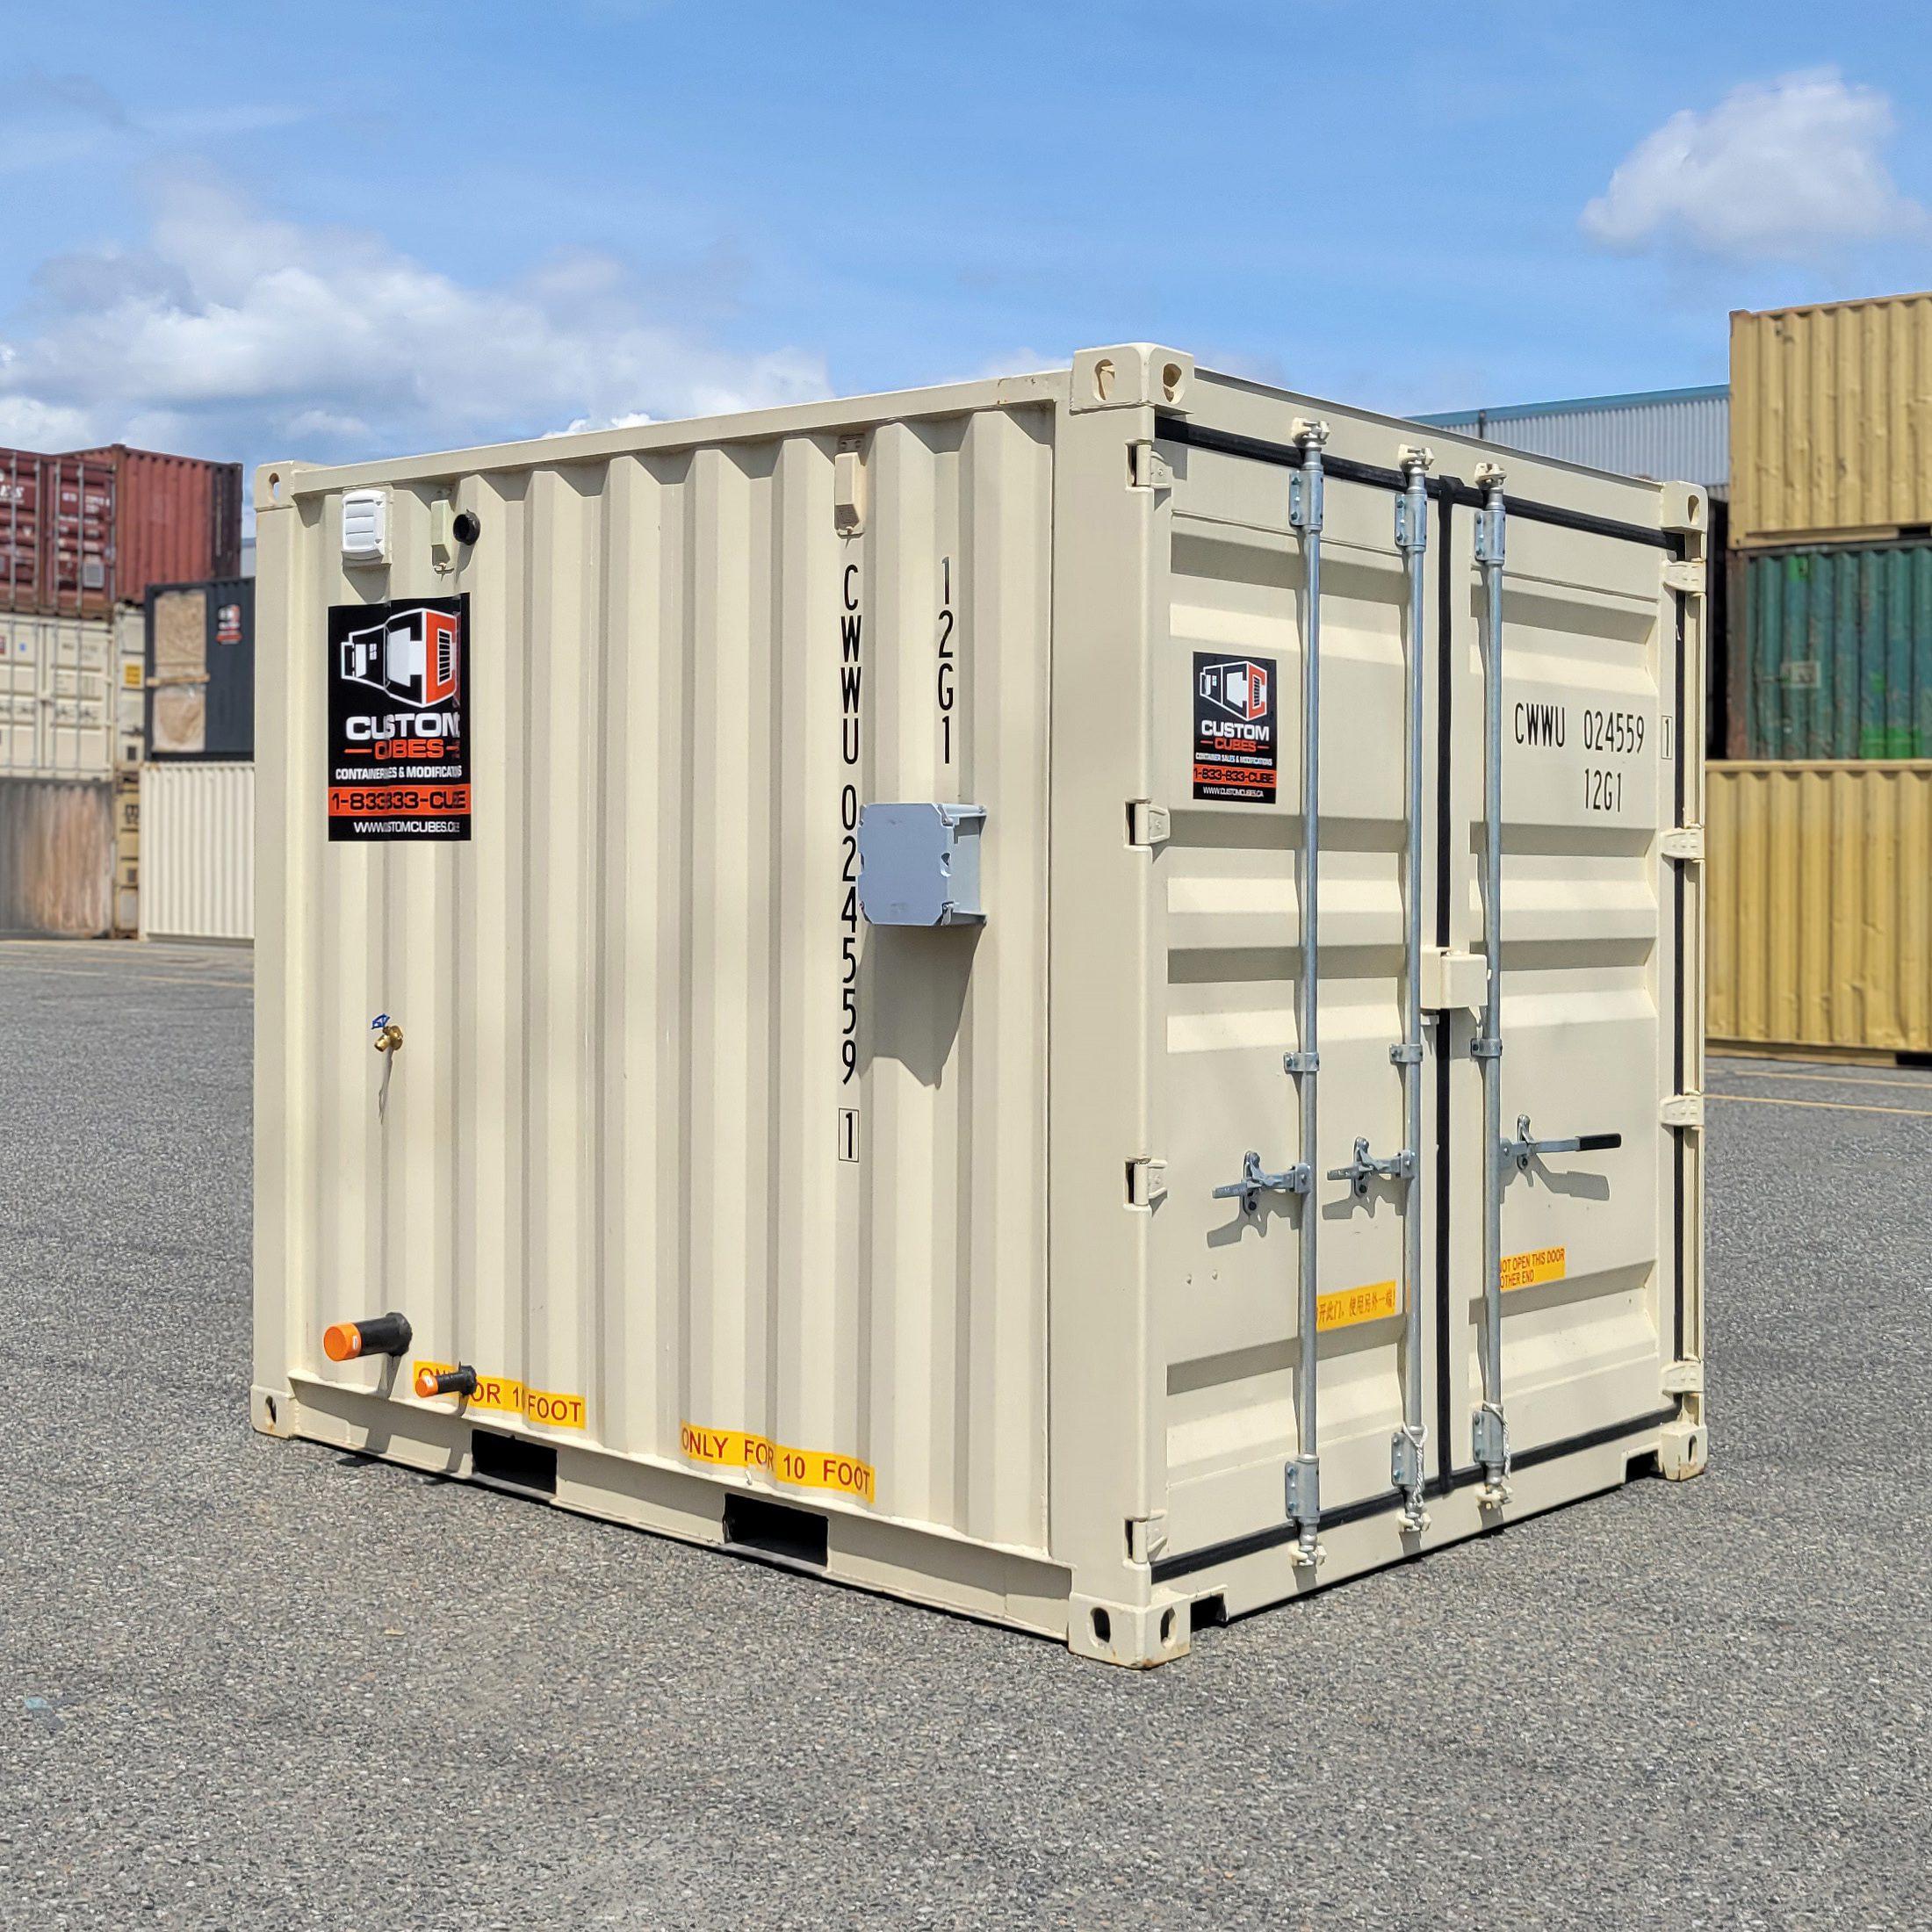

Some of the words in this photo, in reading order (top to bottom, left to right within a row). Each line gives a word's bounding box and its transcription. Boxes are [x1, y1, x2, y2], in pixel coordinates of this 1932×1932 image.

[840, 564, 861, 765] CWWU
[938, 557, 955, 765] 12G1
[1201, 719, 1270, 741] CUSTOM
[1215, 737, 1257, 753] CUBES
[1515, 702, 1566, 747] CWWU
[1583, 710, 1645, 754] 024559
[1584, 768, 1622, 812] 12G1
[840, 784, 858, 1086] 024559
[1512, 1254, 1531, 1271] OPEN
[1532, 1251, 1546, 1265] THIS
[1546, 1247, 1565, 1264] DOOR
[1522, 1269, 1535, 1283] END
[469, 1382, 501, 1404] OR
[528, 1393, 582, 1423] FOOT
[681, 1427, 729, 1459] ONLY
[744, 1438, 774, 1472] FOR
[783, 1453, 806, 1480] 10
[823, 1459, 871, 1495] FOOT
